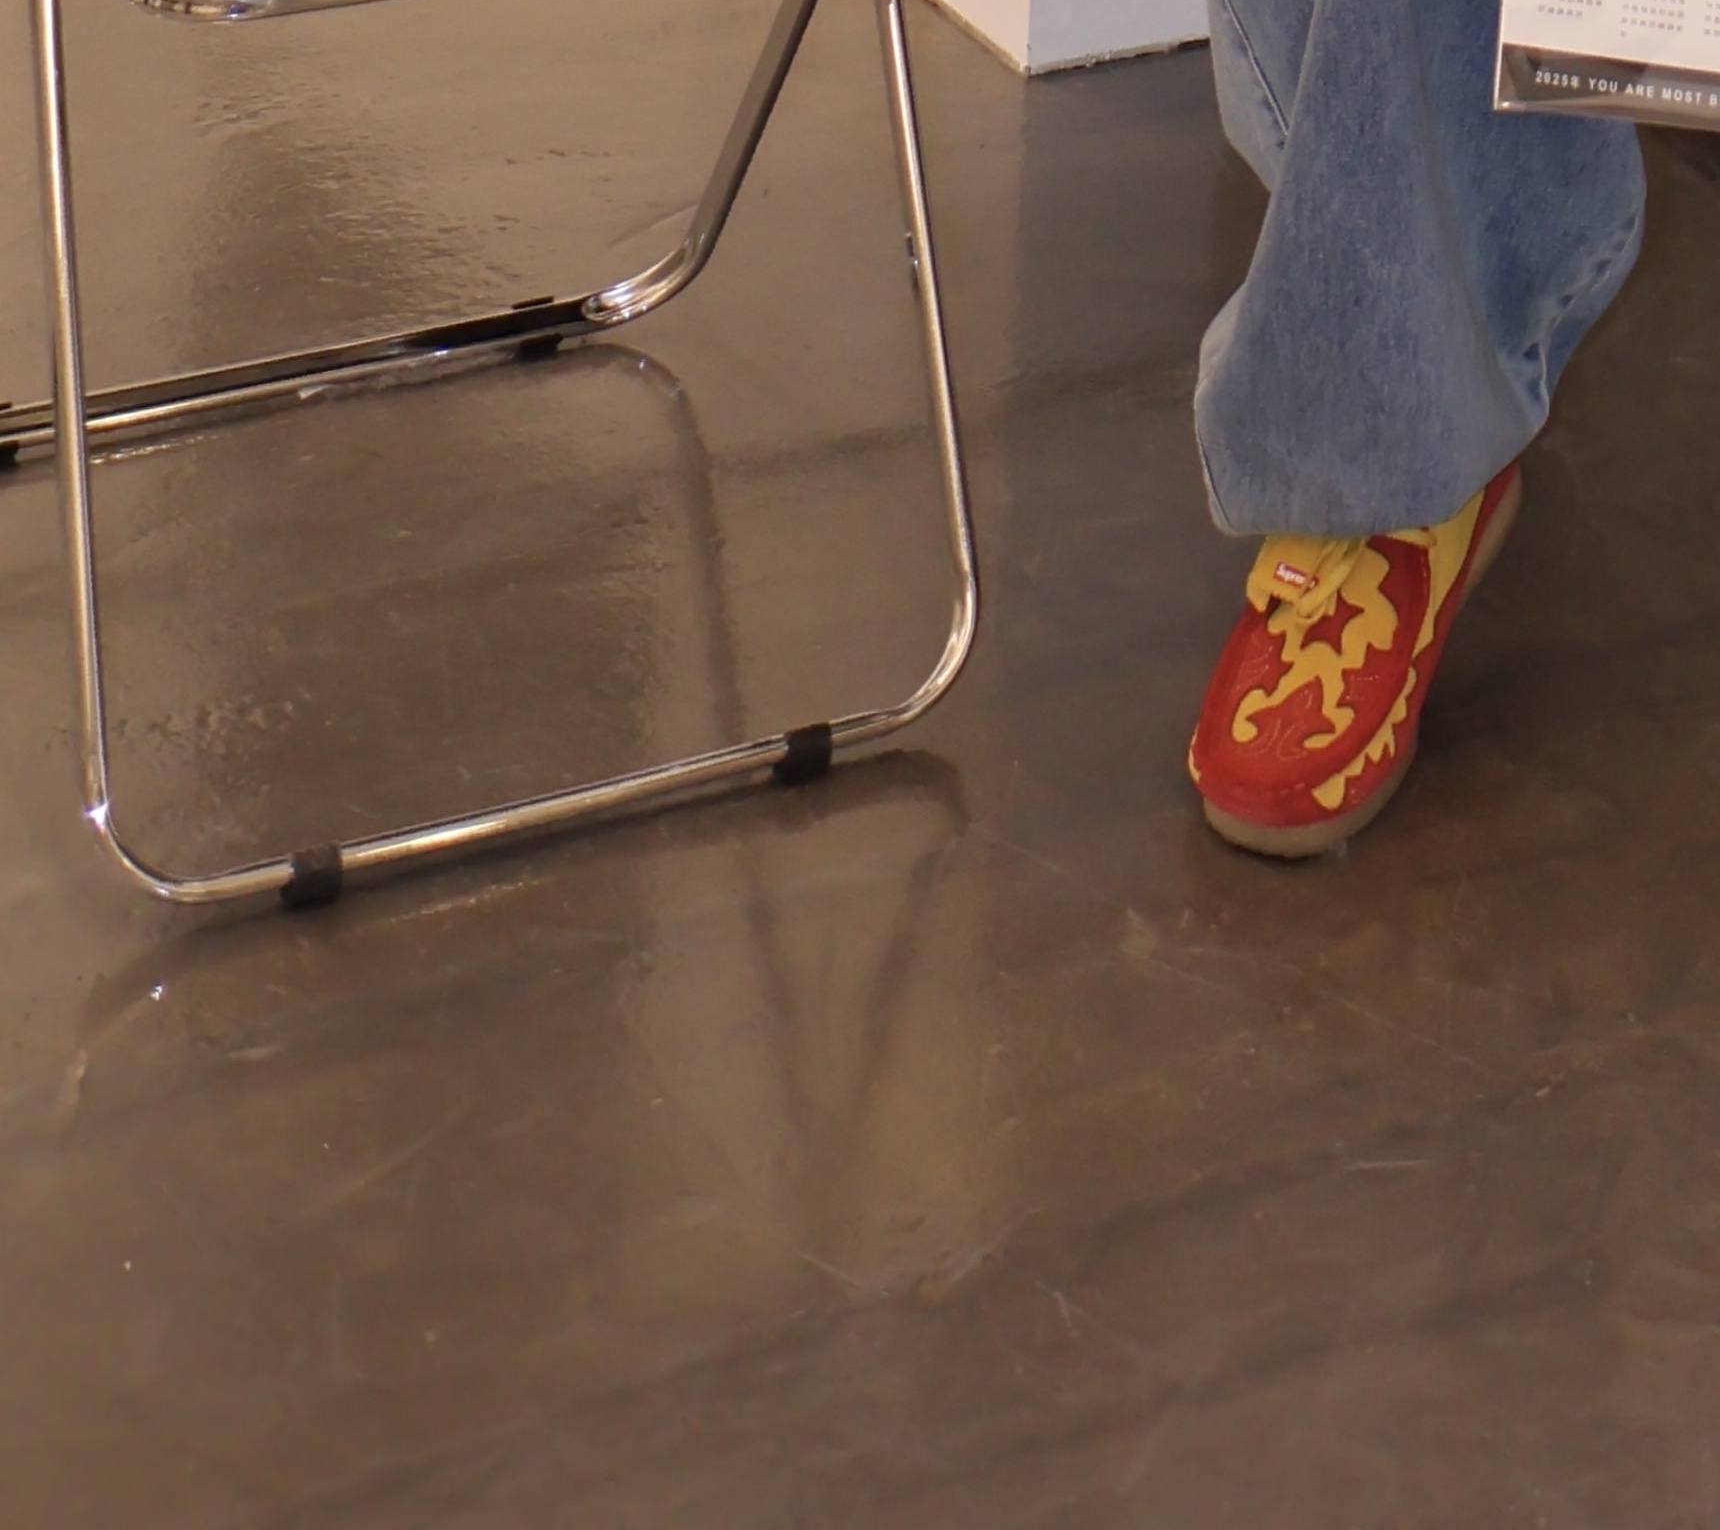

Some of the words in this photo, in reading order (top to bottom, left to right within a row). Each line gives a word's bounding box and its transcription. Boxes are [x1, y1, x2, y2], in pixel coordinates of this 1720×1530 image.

[1588, 77, 1618, 93] YOU
[1624, 83, 1655, 98] ARE
[1662, 87, 1702, 104] MOST
